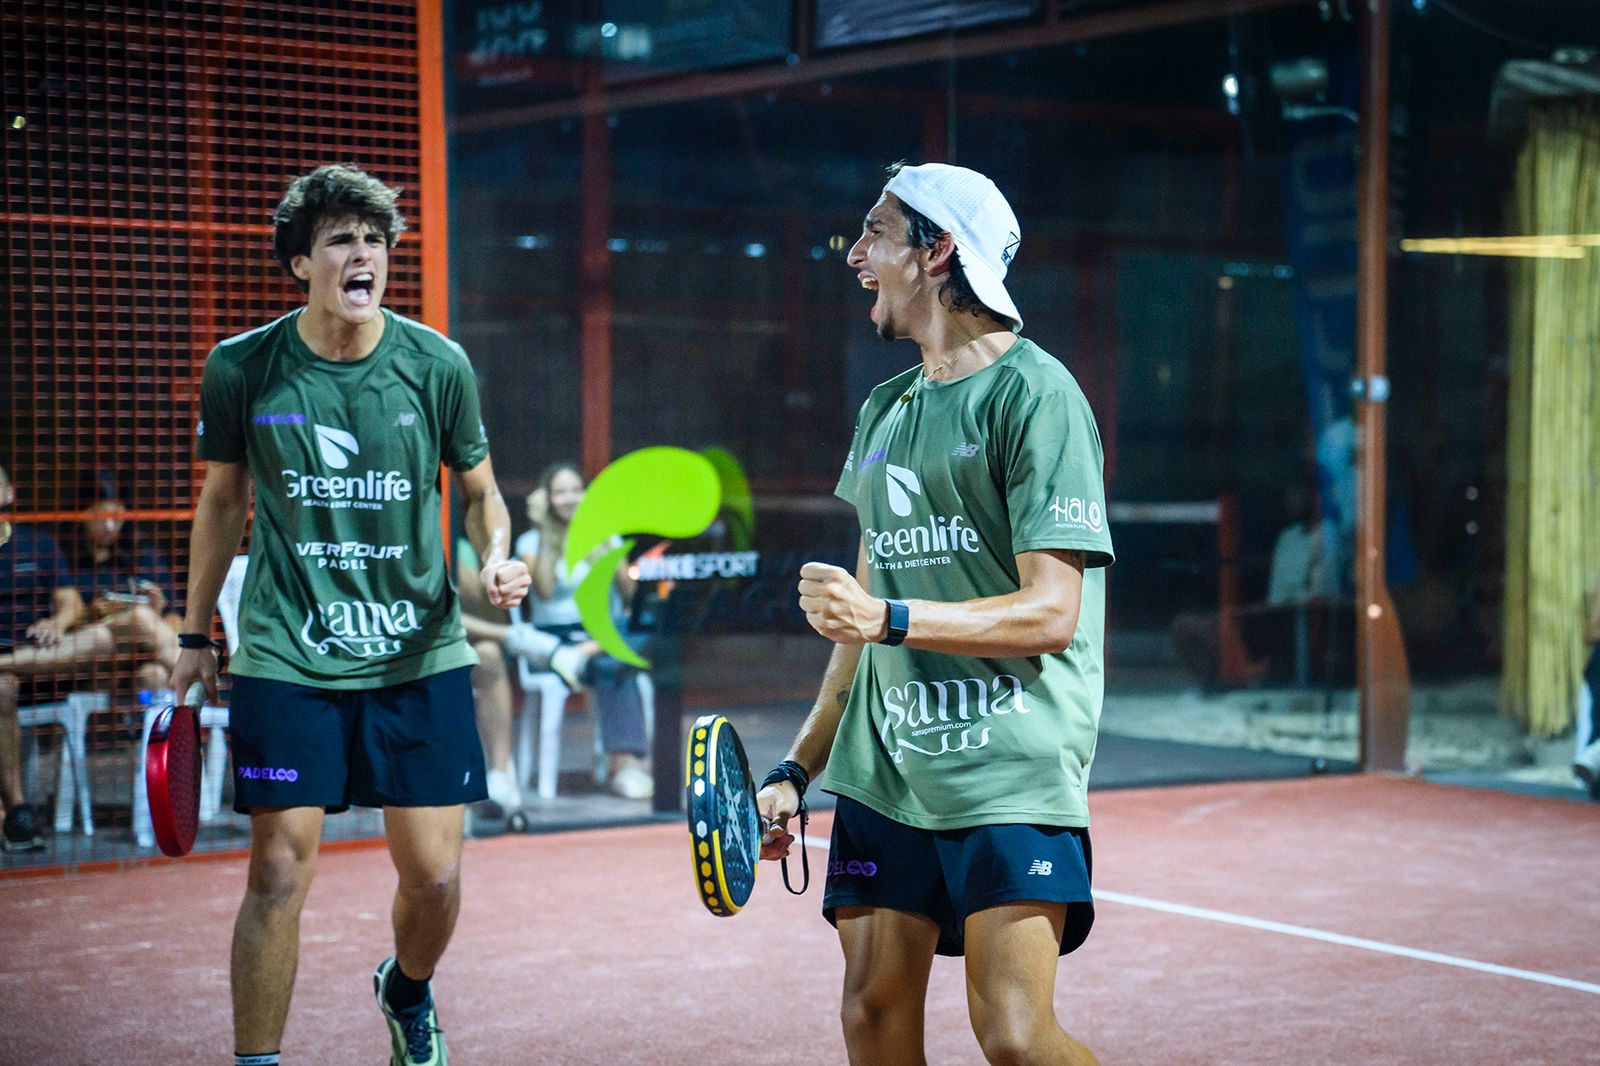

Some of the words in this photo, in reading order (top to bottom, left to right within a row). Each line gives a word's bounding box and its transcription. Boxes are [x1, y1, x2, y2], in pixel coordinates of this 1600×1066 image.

[281, 469, 412, 501] Greenlife
[318, 558, 368, 570] PADEL
[897, 561, 903, 569] &
[883, 674, 1032, 730] sama
